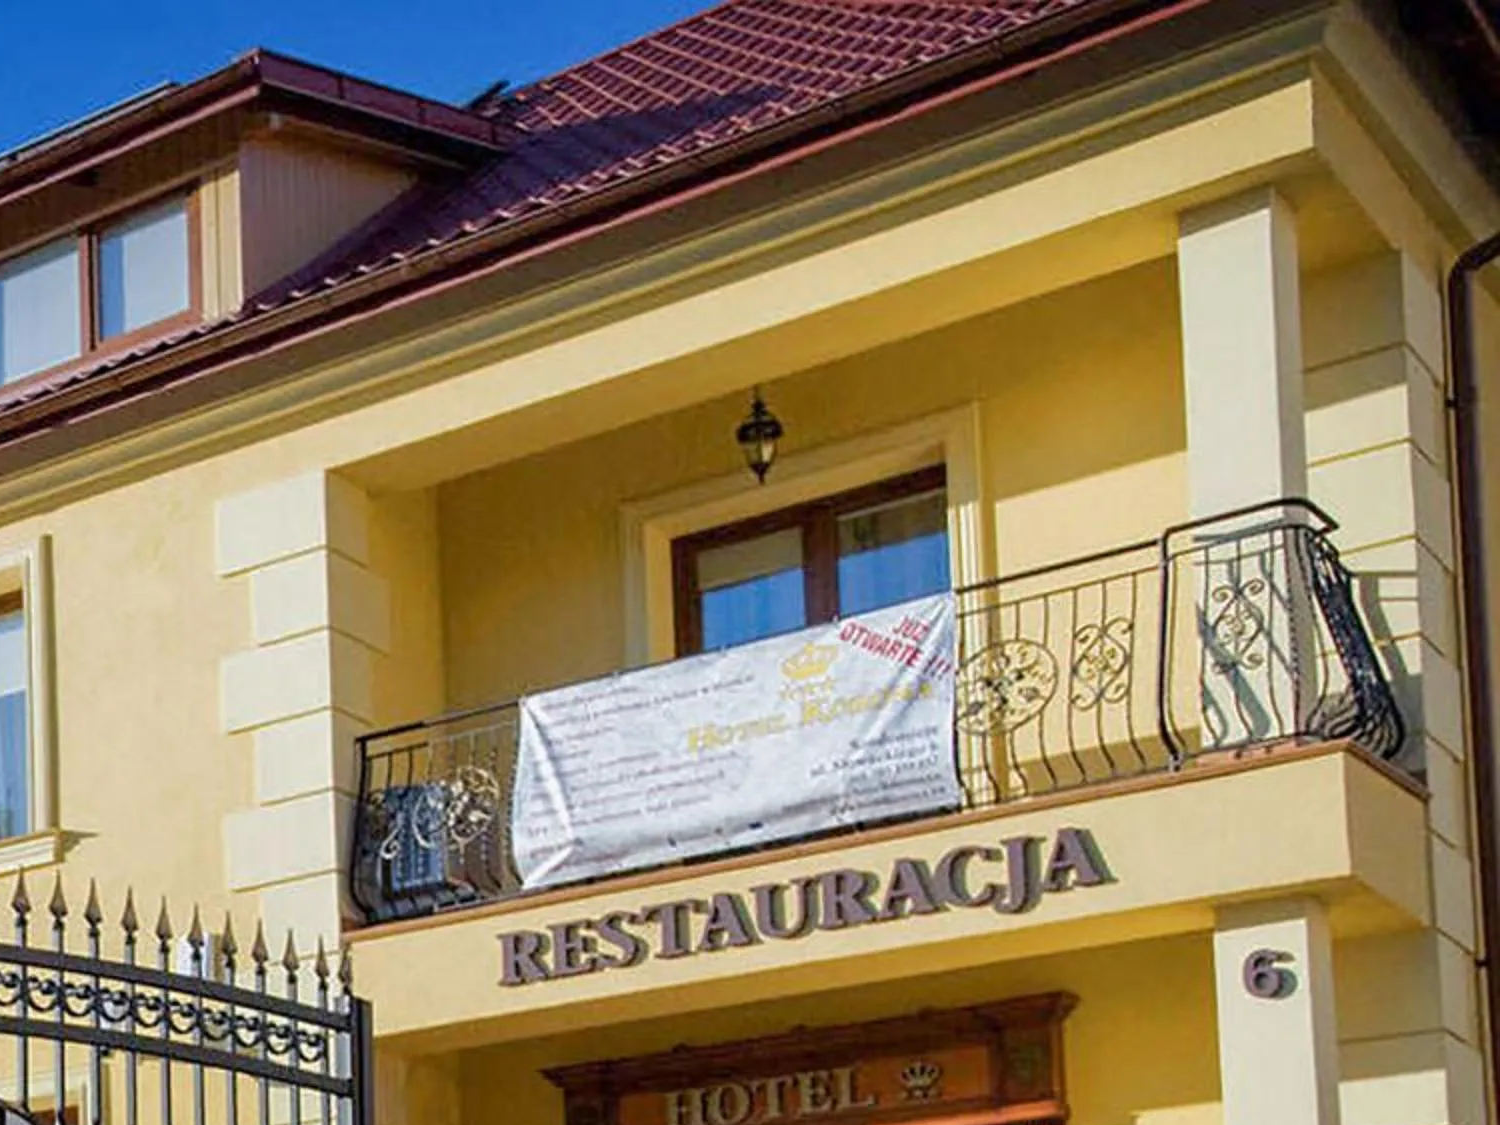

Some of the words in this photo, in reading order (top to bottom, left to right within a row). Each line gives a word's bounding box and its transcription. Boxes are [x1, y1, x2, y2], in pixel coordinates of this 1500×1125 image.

[839, 621, 924, 667] OTWARTE
[497, 827, 1118, 987] RESTAURACJA
[1243, 948, 1298, 1001] 6
